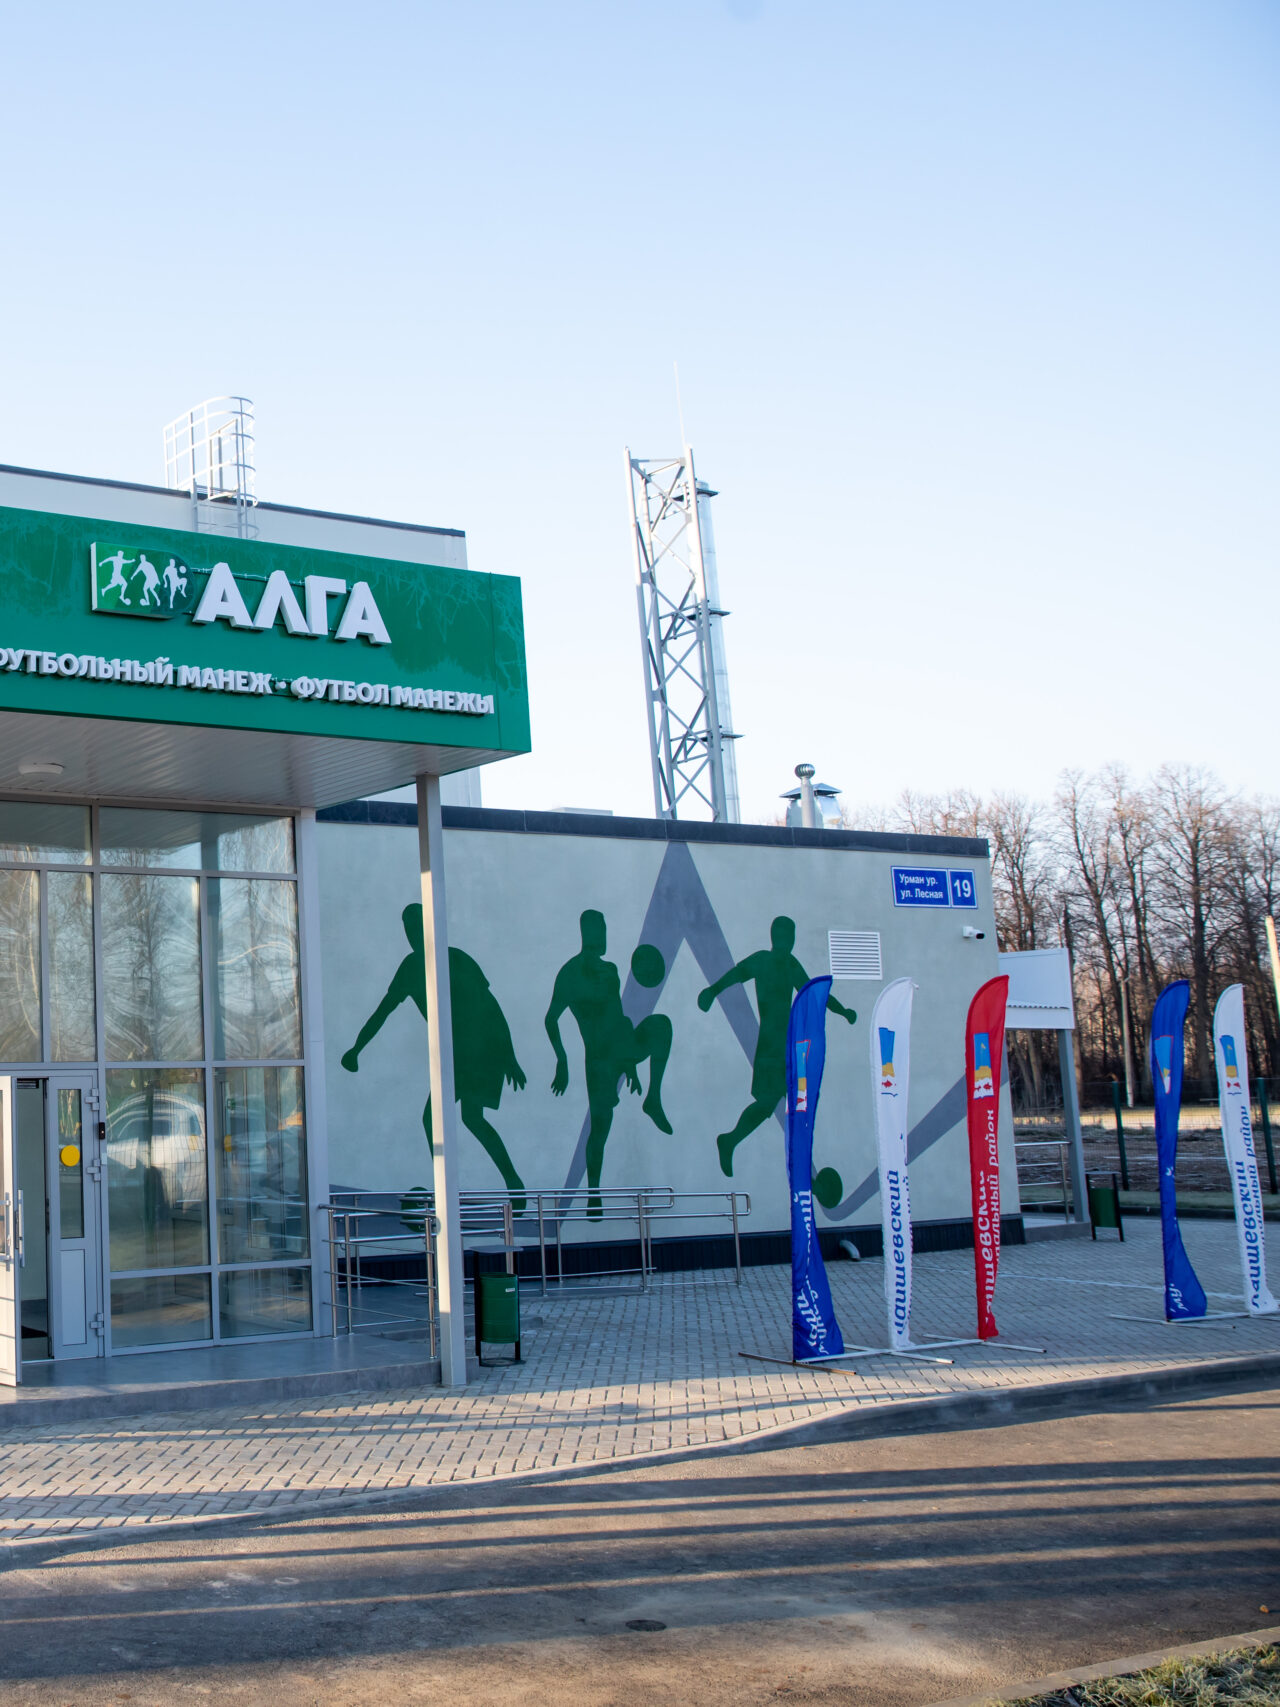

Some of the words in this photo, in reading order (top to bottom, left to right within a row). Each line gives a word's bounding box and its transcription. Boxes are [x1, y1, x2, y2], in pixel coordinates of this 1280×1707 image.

[192, 562, 392, 644] АЛГА
[177, 665, 273, 694] МАНЕЖ
[291, 676, 389, 706] ФУТБОЛ
[391, 686, 495, 714] МАНЕЖЫ
[899, 873, 924, 885] Урман
[926, 876, 938, 886] ур.
[900, 889, 913, 900] ул.
[915, 888, 943, 899] Лесная
[953, 879, 972, 898] 19
[984, 1109, 1000, 1167] район
